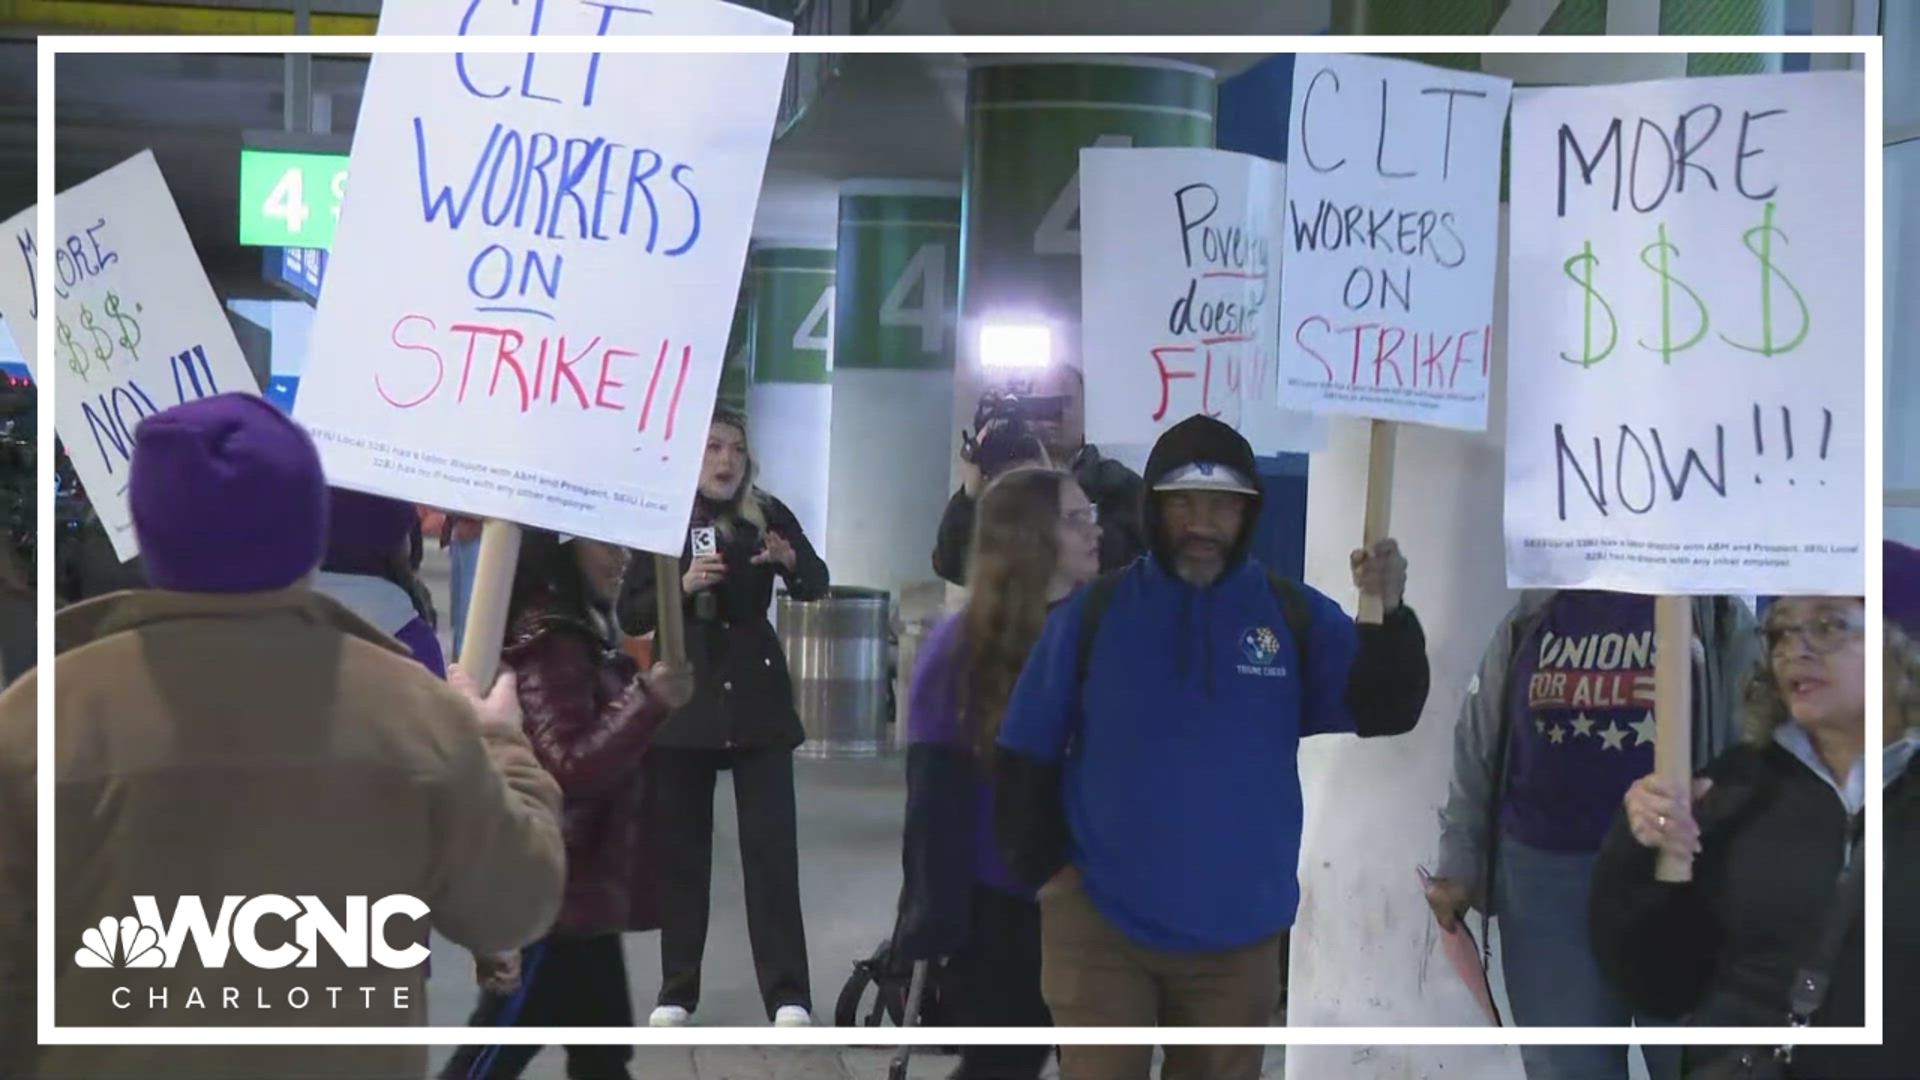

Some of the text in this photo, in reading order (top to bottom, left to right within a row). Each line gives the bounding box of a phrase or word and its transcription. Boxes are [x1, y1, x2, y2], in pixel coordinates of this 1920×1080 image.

[455, 0, 653, 107] CLT
[1302, 68, 1487, 182] CLT
[1557, 104, 1788, 217] MORE
[262, 166, 311, 234] 4
[414, 116, 700, 256] WORKERS
[1290, 199, 1466, 268] WORKERS
[467, 244, 563, 299] ON
[879, 243, 959, 352] 4
[1343, 266, 1411, 312] ON
[375, 314, 692, 463] STRIKE!!
[1529, 672, 1628, 707] FOR ALL
